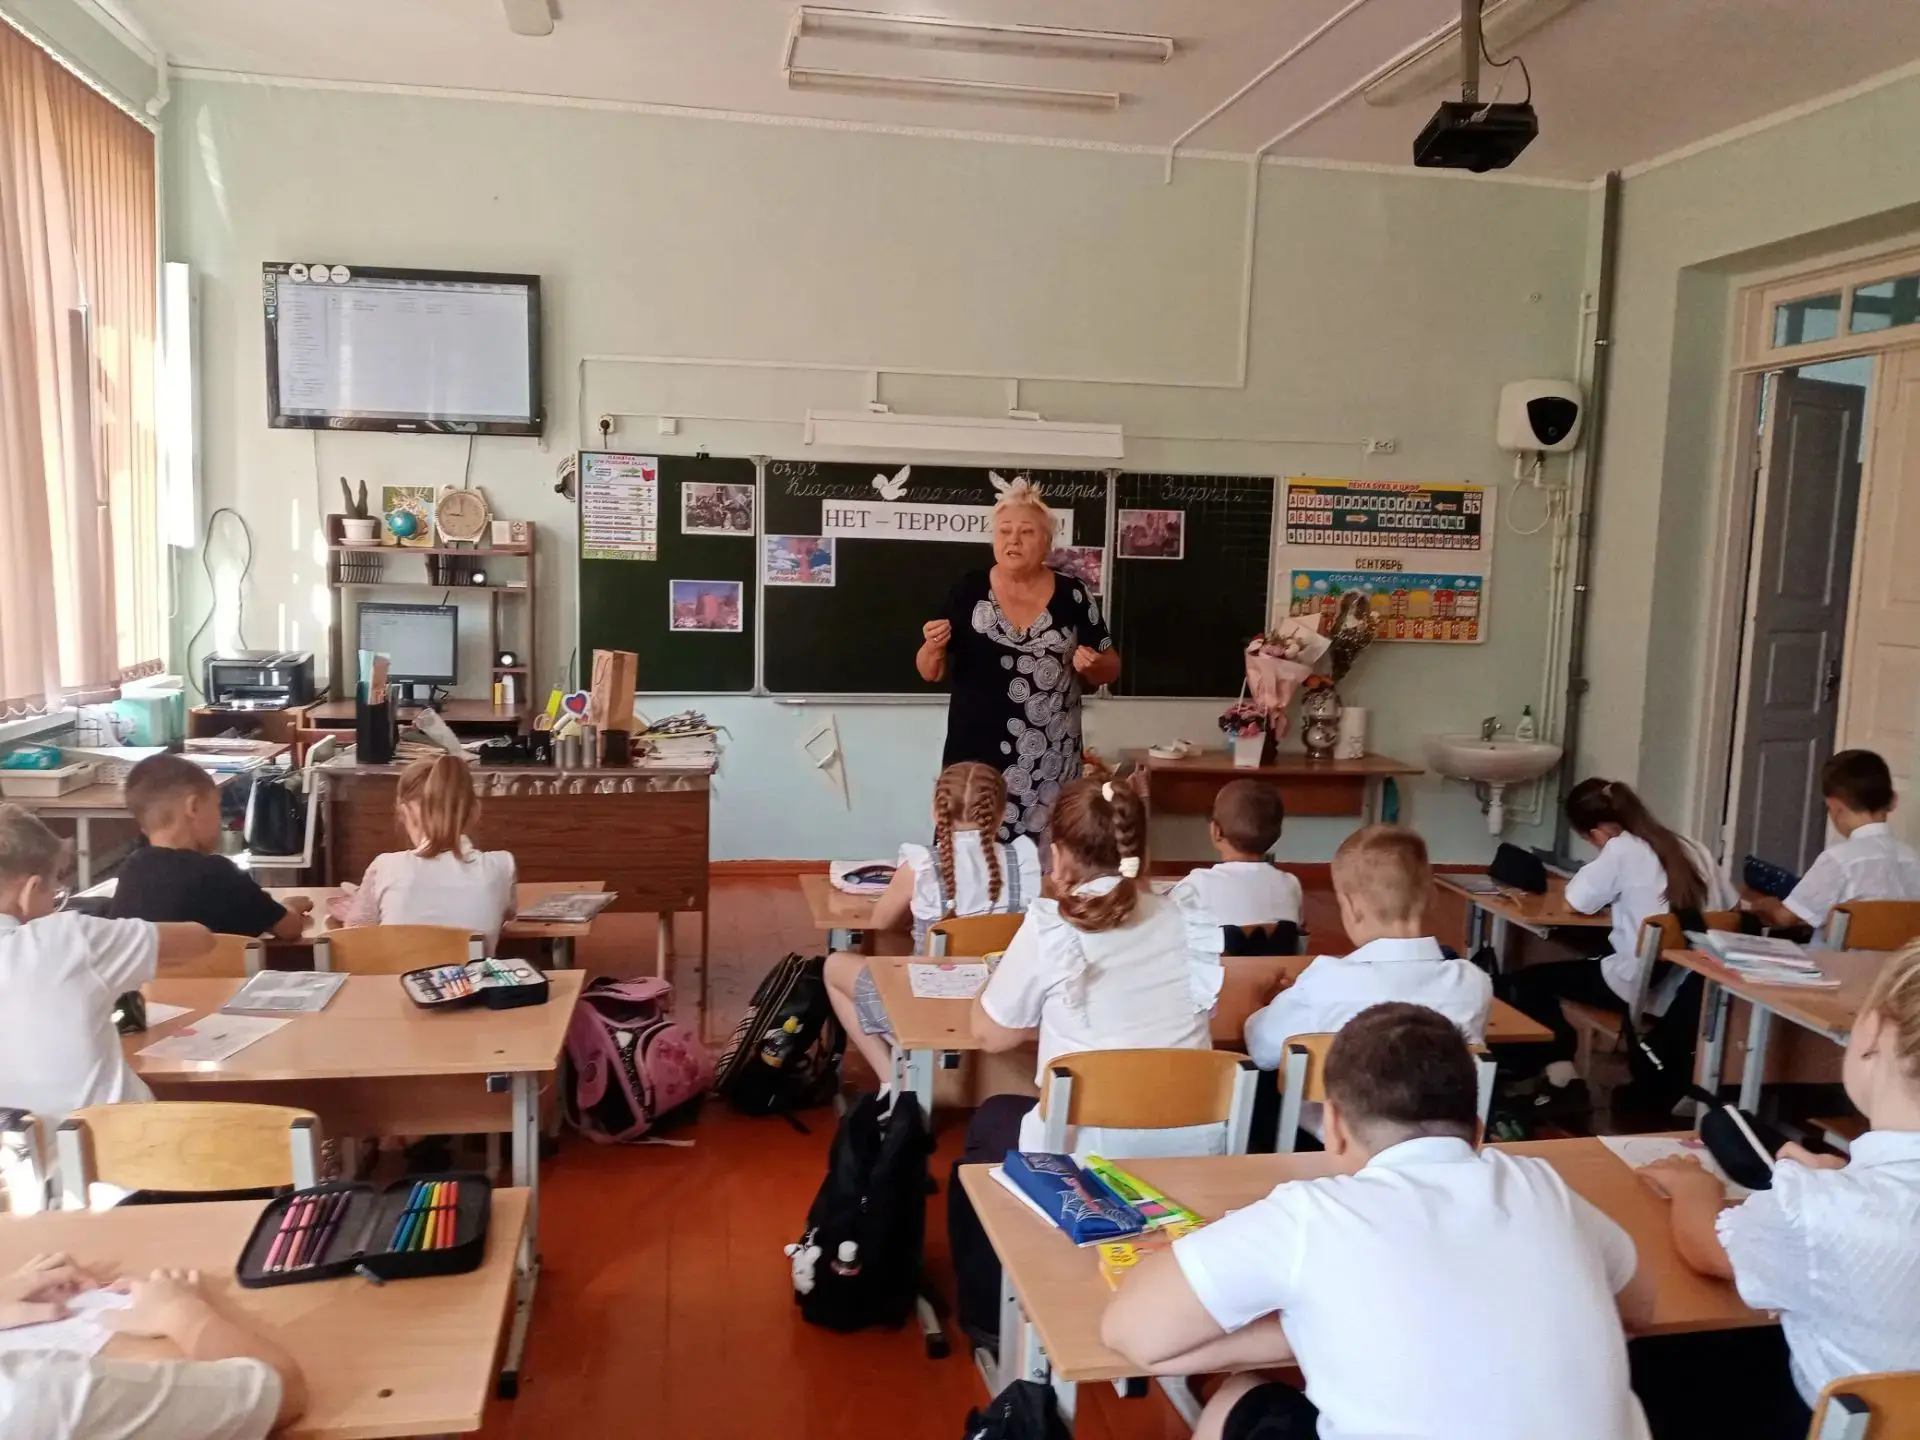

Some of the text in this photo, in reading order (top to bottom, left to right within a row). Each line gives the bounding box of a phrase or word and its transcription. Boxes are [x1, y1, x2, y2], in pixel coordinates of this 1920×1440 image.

[824, 509, 872, 529] НЕТ
[893, 511, 1066, 536] ТЕРРОРИ!
[1355, 558, 1403, 571] СЕНТЯБРЬ
